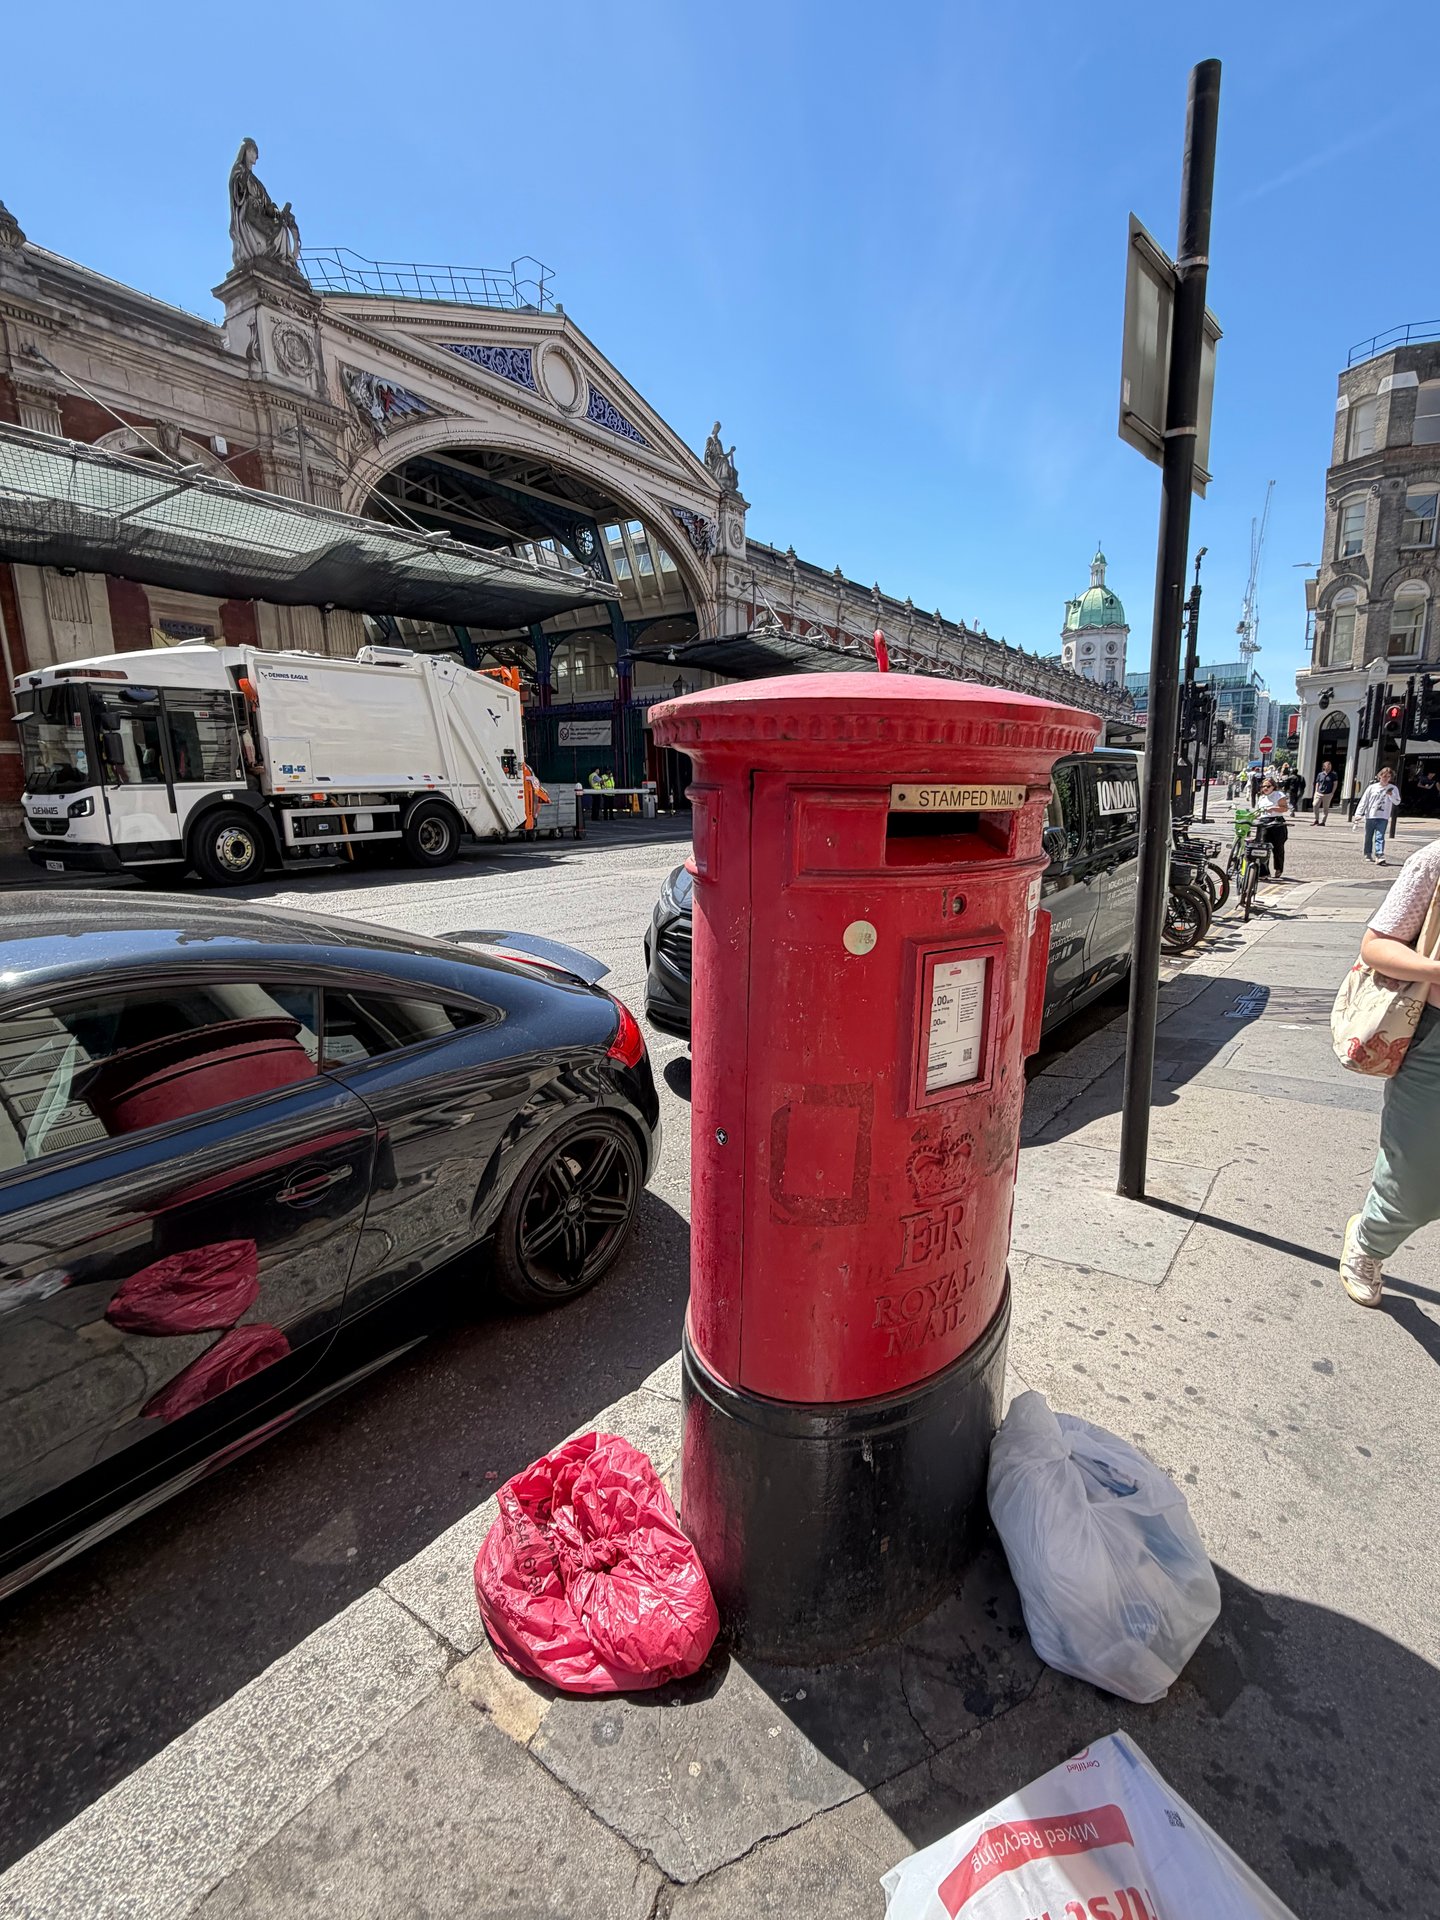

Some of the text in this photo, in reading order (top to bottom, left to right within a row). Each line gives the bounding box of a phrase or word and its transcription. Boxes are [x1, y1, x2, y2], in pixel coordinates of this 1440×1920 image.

[32, 806, 59, 815] DENNIS
[918, 789, 1014, 807] STAMPED MAIL
[1096, 780, 1137, 816] LONDON
[872, 1260, 977, 1329] ROYAL
[883, 1297, 967, 1358] MAIL
[1066, 1760, 1100, 1773] Certified
[971, 1822, 1100, 1875] Mixed Recycling
[1065, 1886, 1158, 1920] irst
